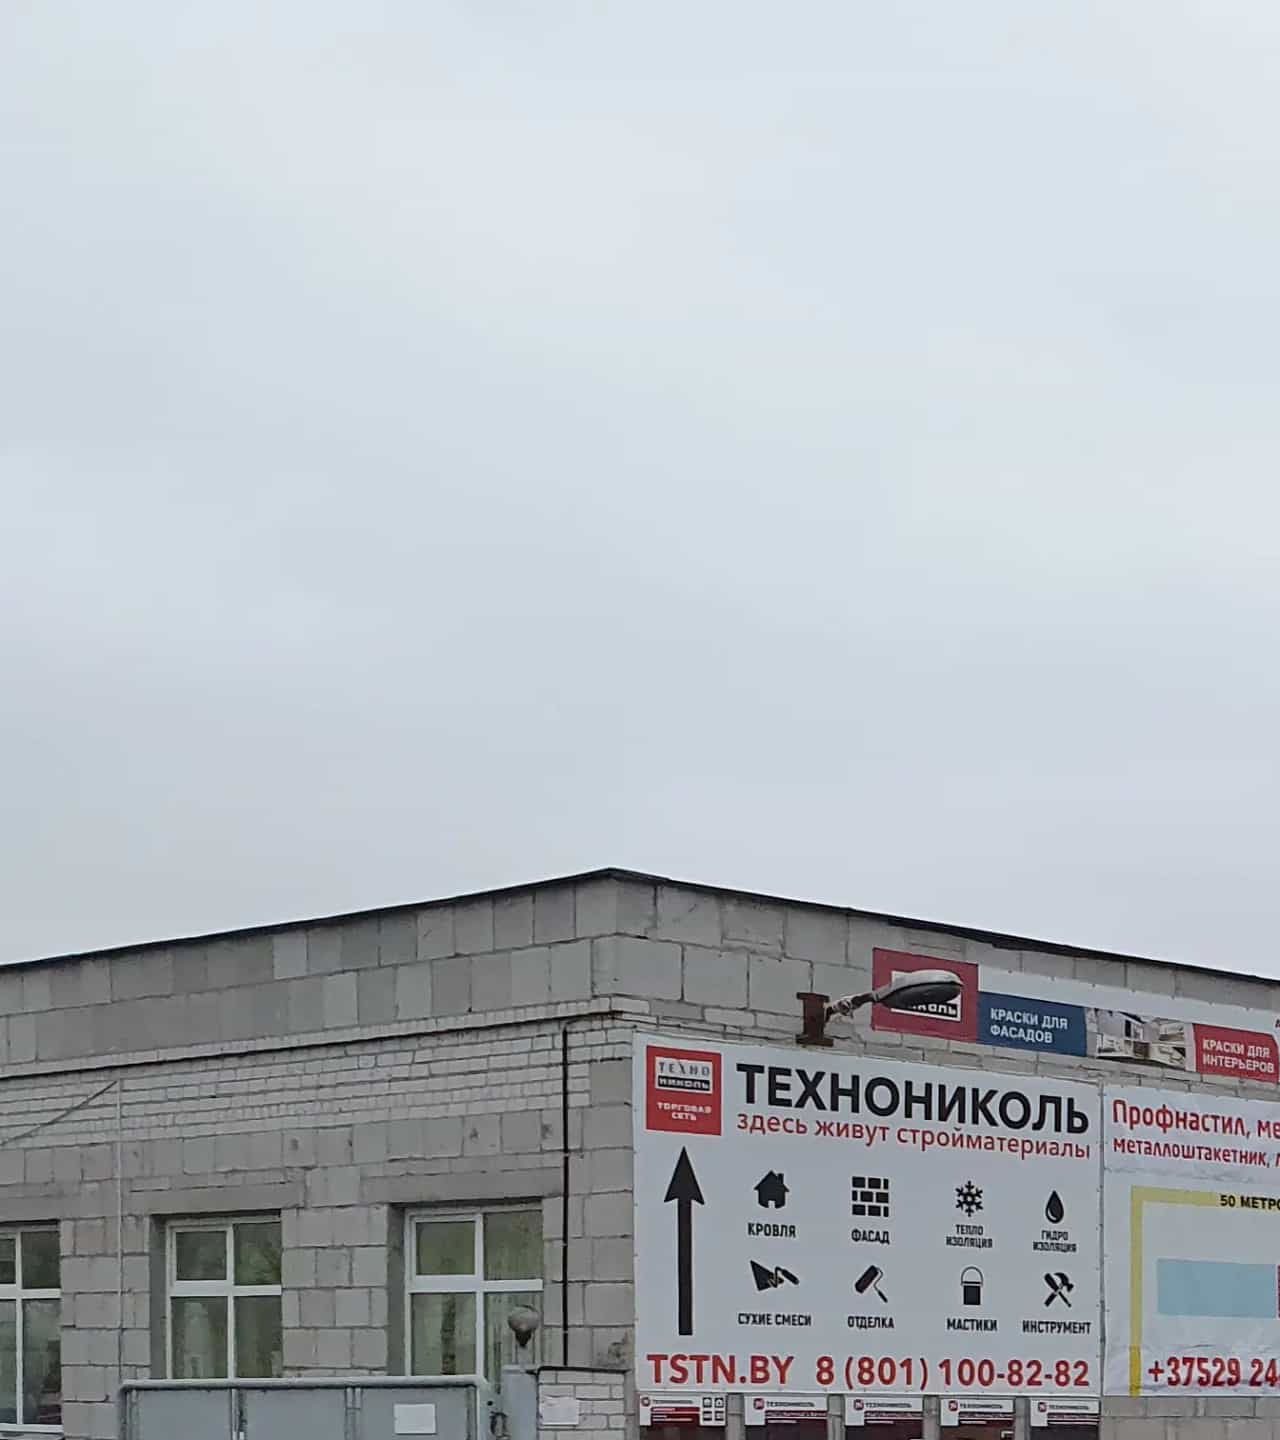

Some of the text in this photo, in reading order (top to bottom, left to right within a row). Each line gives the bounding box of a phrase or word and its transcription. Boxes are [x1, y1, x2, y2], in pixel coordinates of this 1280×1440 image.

[990, 1008, 1069, 1031] КРАСКИ ДЛЯ
[990, 1024, 1053, 1044] ФАСАДОВ
[1203, 1039, 1271, 1058] КРАСКИ ДЛЯ
[1203, 1054, 1275, 1074] ИНТЕРЬЕРОВ
[736, 1063, 1089, 1134] ТЕХНОНИКОЛЬ
[657, 1101, 712, 1114] ТОРГОВАЯ
[671, 1111, 697, 1121] СЕТЬ
[1112, 1099, 1251, 1139] Профнастил,
[737, 1113, 1090, 1160] здесь живут стройматериалы
[1113, 1137, 1270, 1169] металлоштакетник,
[1220, 1194, 1236, 1207] 50
[747, 1222, 797, 1238] КРОВЛЯ
[851, 1228, 890, 1245] ФАСАД
[956, 1224, 984, 1236] ТЕПЛО
[1041, 1230, 1069, 1242] ГИДРО
[946, 1236, 993, 1249] ИЗОЛЯЦИЯ
[1033, 1241, 1077, 1253] ИЗОЛЯЦИЯ
[738, 1312, 812, 1327] СУХИЕ СМЕСИ
[847, 1315, 895, 1330] ОТДЕЛКА
[946, 1318, 998, 1332] МАСТИКИ
[1022, 1320, 1092, 1335] ИНСТРУМЕНТ
[646, 1353, 1089, 1391] TSTN.BY 8 (801) 100-82-82
[1148, 1356, 1241, 1387] +37529
